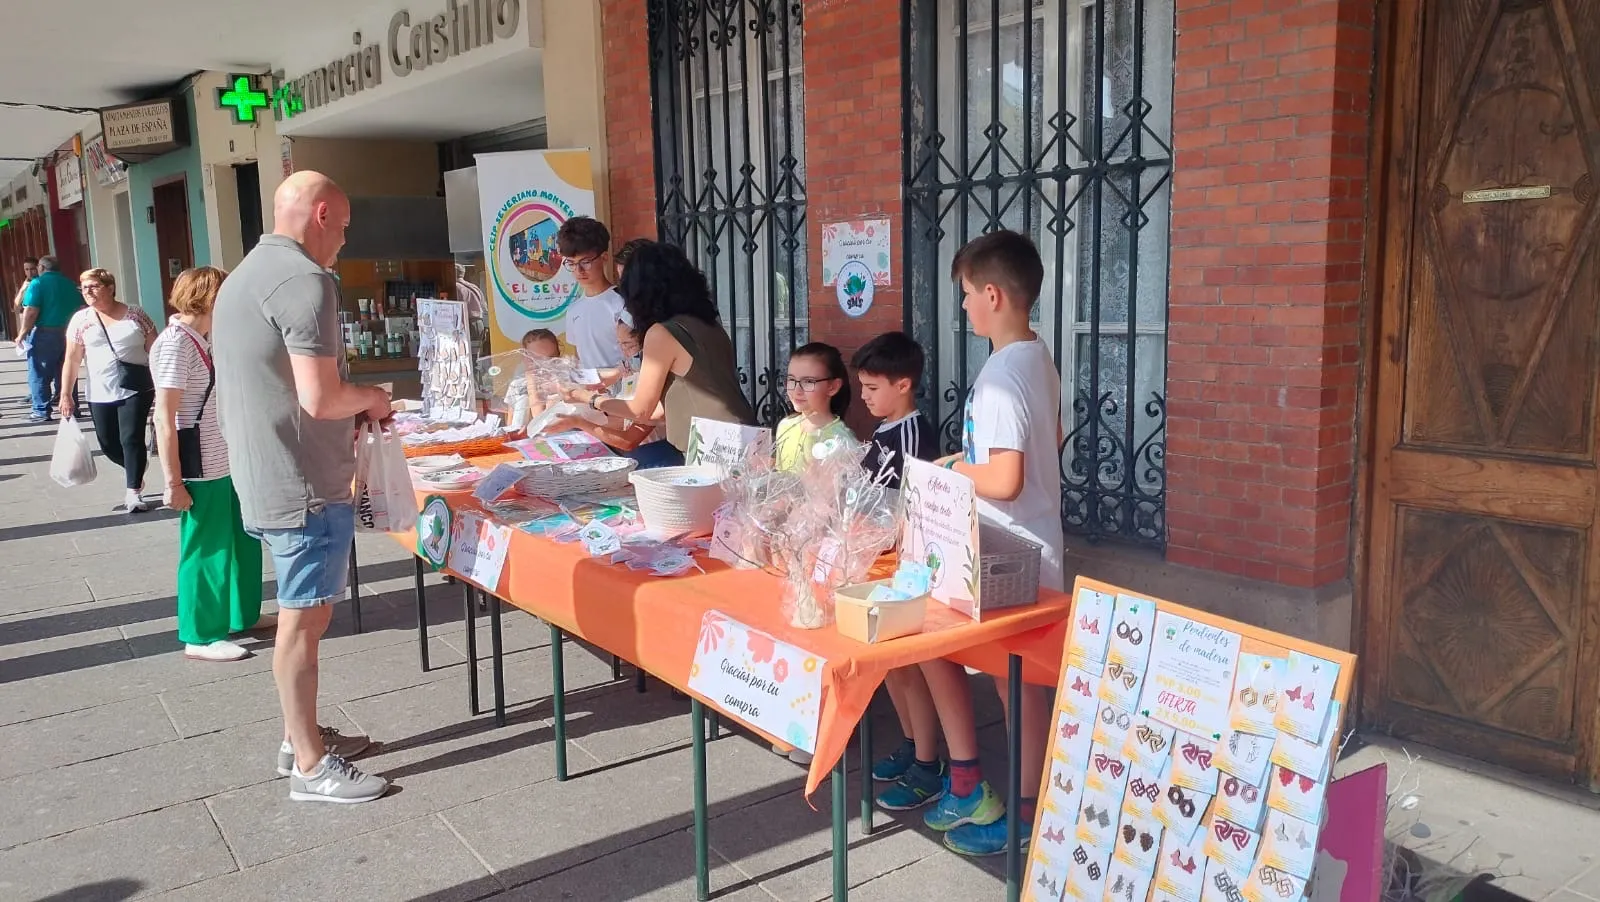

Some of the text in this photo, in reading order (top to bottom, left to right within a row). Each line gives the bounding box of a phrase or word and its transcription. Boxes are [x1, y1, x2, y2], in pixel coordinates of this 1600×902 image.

[272, 0, 520, 121] Farmacia Castillo
[109, 118, 168, 137] PLAZA DE ESPAÑA
[495, 189, 538, 225] SEVERIANO
[540, 190, 575, 218] MONTER
[1183, 620, 1231, 648] Pendientes
[1179, 639, 1230, 665] de madera
[720, 657, 780, 697] Gracias por tu
[724, 693, 760, 718] compra
[1157, 690, 1197, 716] OFERTA
